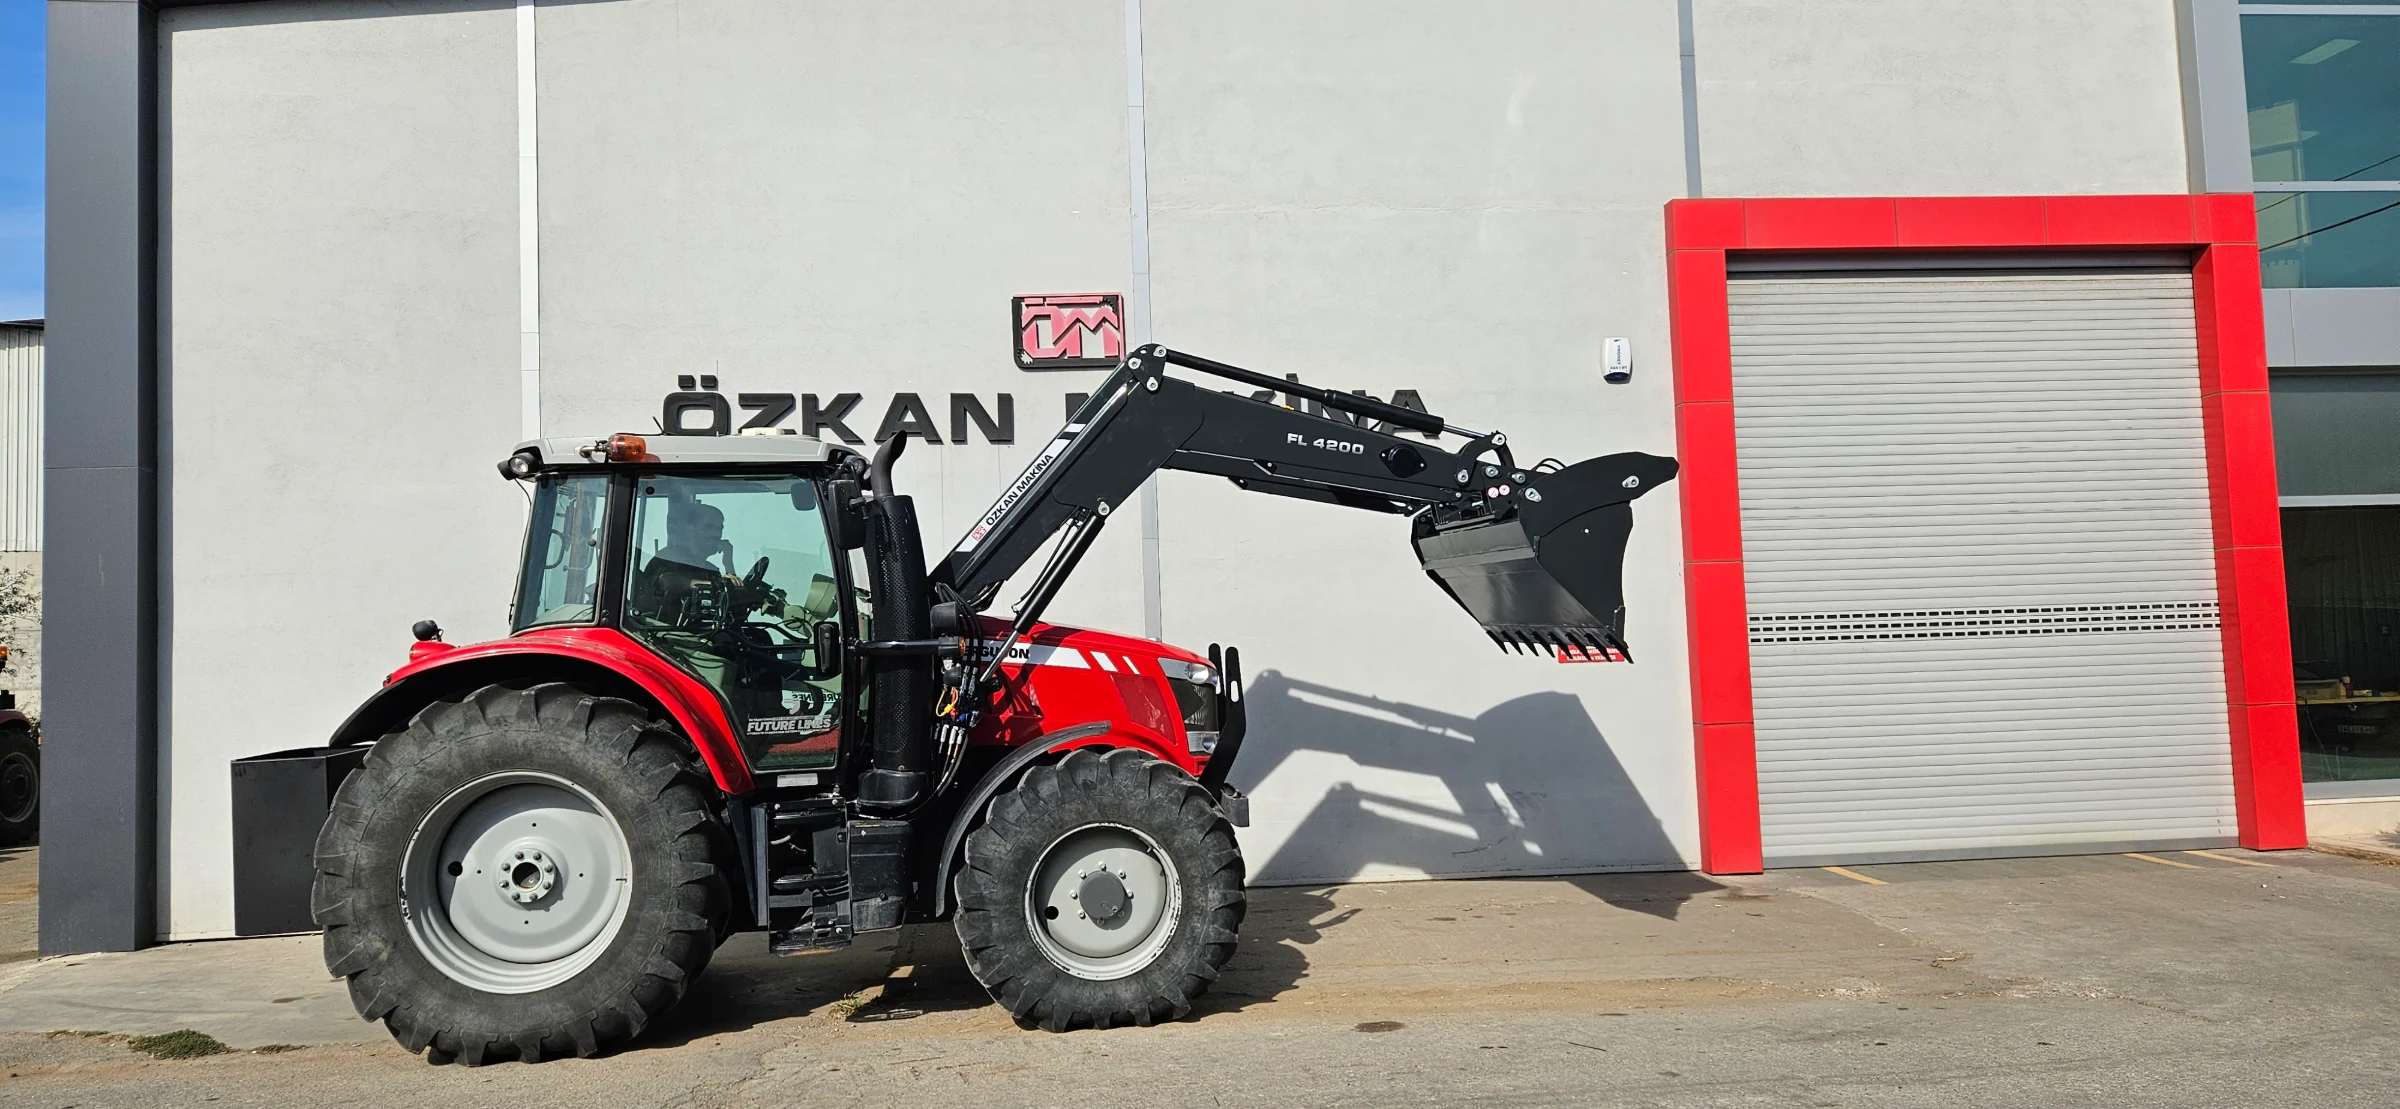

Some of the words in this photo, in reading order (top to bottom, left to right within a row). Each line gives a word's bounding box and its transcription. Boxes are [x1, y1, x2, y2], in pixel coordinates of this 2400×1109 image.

[663, 374, 1014, 445] ÖZKAN
[1286, 432, 1307, 448] FL
[1312, 436, 1364, 455] 4200
[985, 490, 1019, 527] ÖZKAN
[1016, 454, 1054, 493] MAKİNA
[747, 720, 796, 732] FUTURE
[797, 718, 831, 730] LINES
